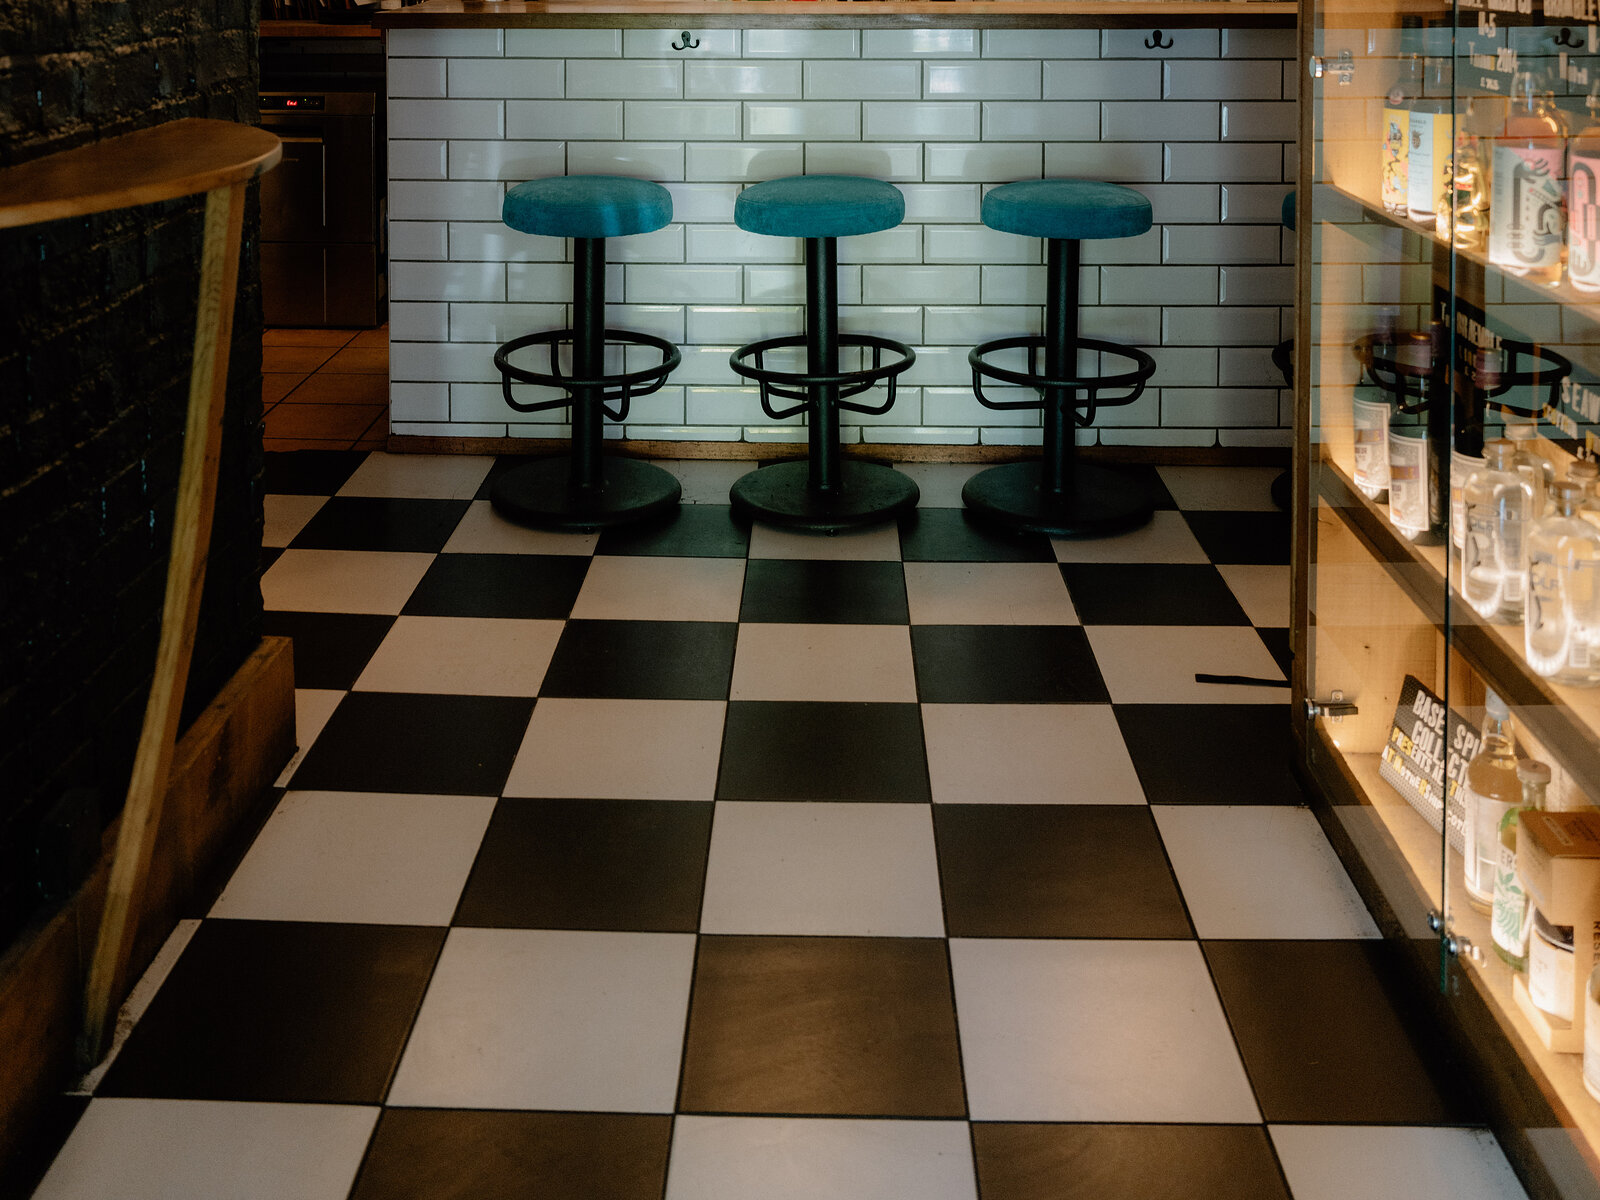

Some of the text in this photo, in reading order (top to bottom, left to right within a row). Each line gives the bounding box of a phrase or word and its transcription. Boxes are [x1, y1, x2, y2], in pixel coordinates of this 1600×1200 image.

[1412, 689, 1446, 736] BASE
[1381, 744, 1396, 764] AT
[1391, 726, 1432, 774] PRESENTS
